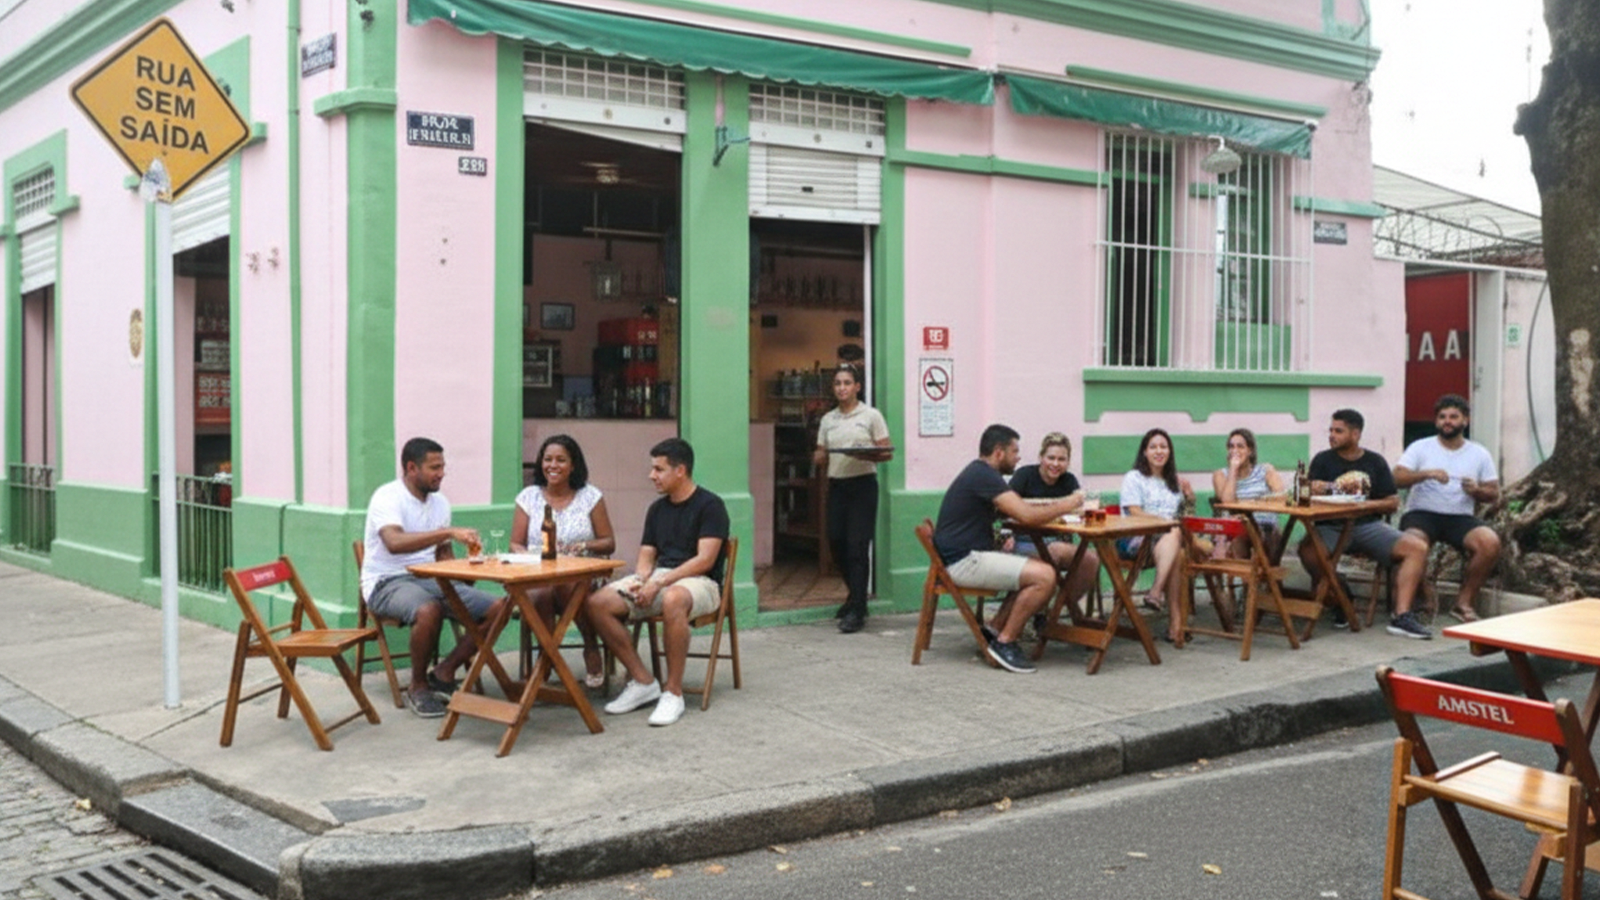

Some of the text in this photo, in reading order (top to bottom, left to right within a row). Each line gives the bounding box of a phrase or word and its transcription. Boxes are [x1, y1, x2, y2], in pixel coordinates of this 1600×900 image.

[136, 55, 195, 91] RUA
[135, 86, 195, 120] SEM
[120, 115, 209, 155] SAÍDA
[1437, 694, 1514, 725] AMSTEL
